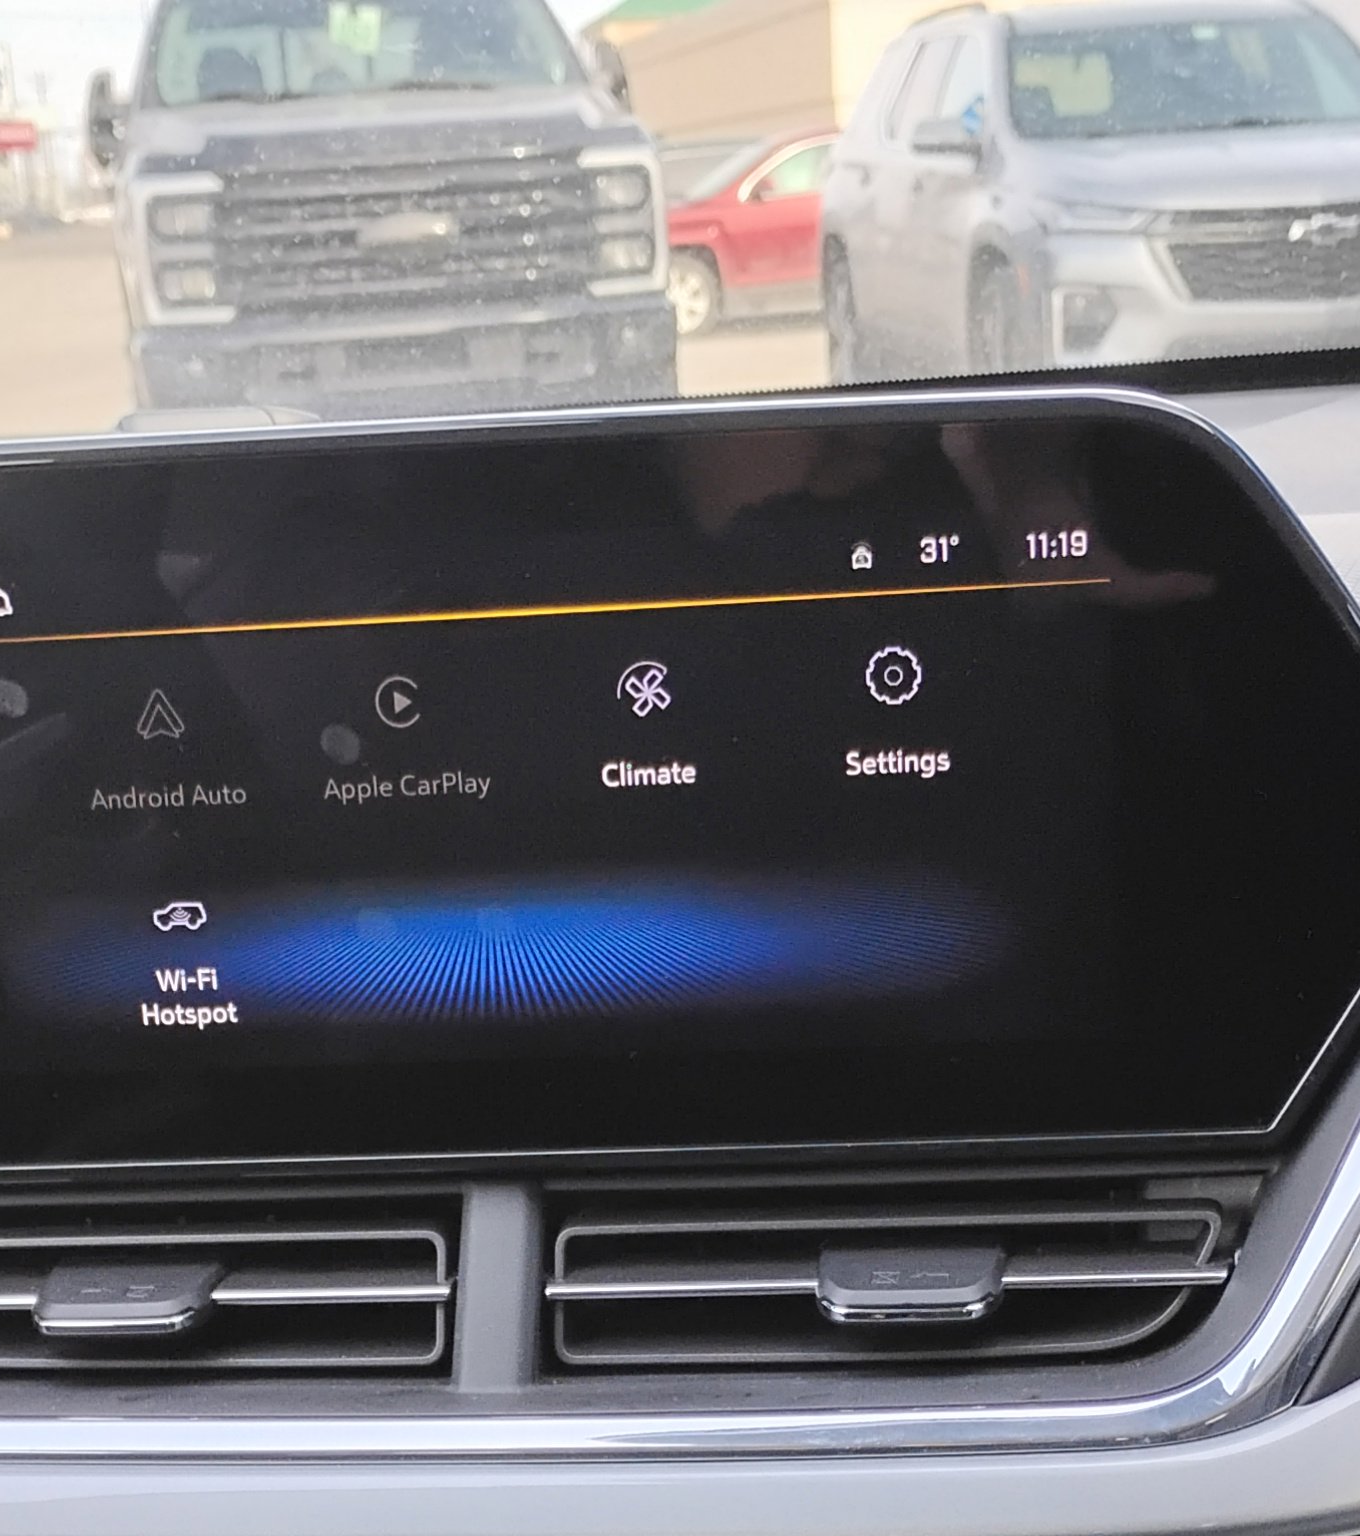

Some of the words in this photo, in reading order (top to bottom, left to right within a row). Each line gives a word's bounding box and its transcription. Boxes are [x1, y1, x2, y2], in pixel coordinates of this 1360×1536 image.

[919, 535, 960, 564] 31°
[1026, 530, 1088, 559] 11:19
[601, 761, 697, 788] Climate
[845, 749, 951, 779] Settings
[90, 785, 185, 811] Android
[192, 783, 247, 805] Auto
[323, 776, 393, 804] Apple
[399, 771, 491, 798] CarPlay
[155, 968, 218, 992] Wi-Fi
[141, 1001, 239, 1030] Hotspot
